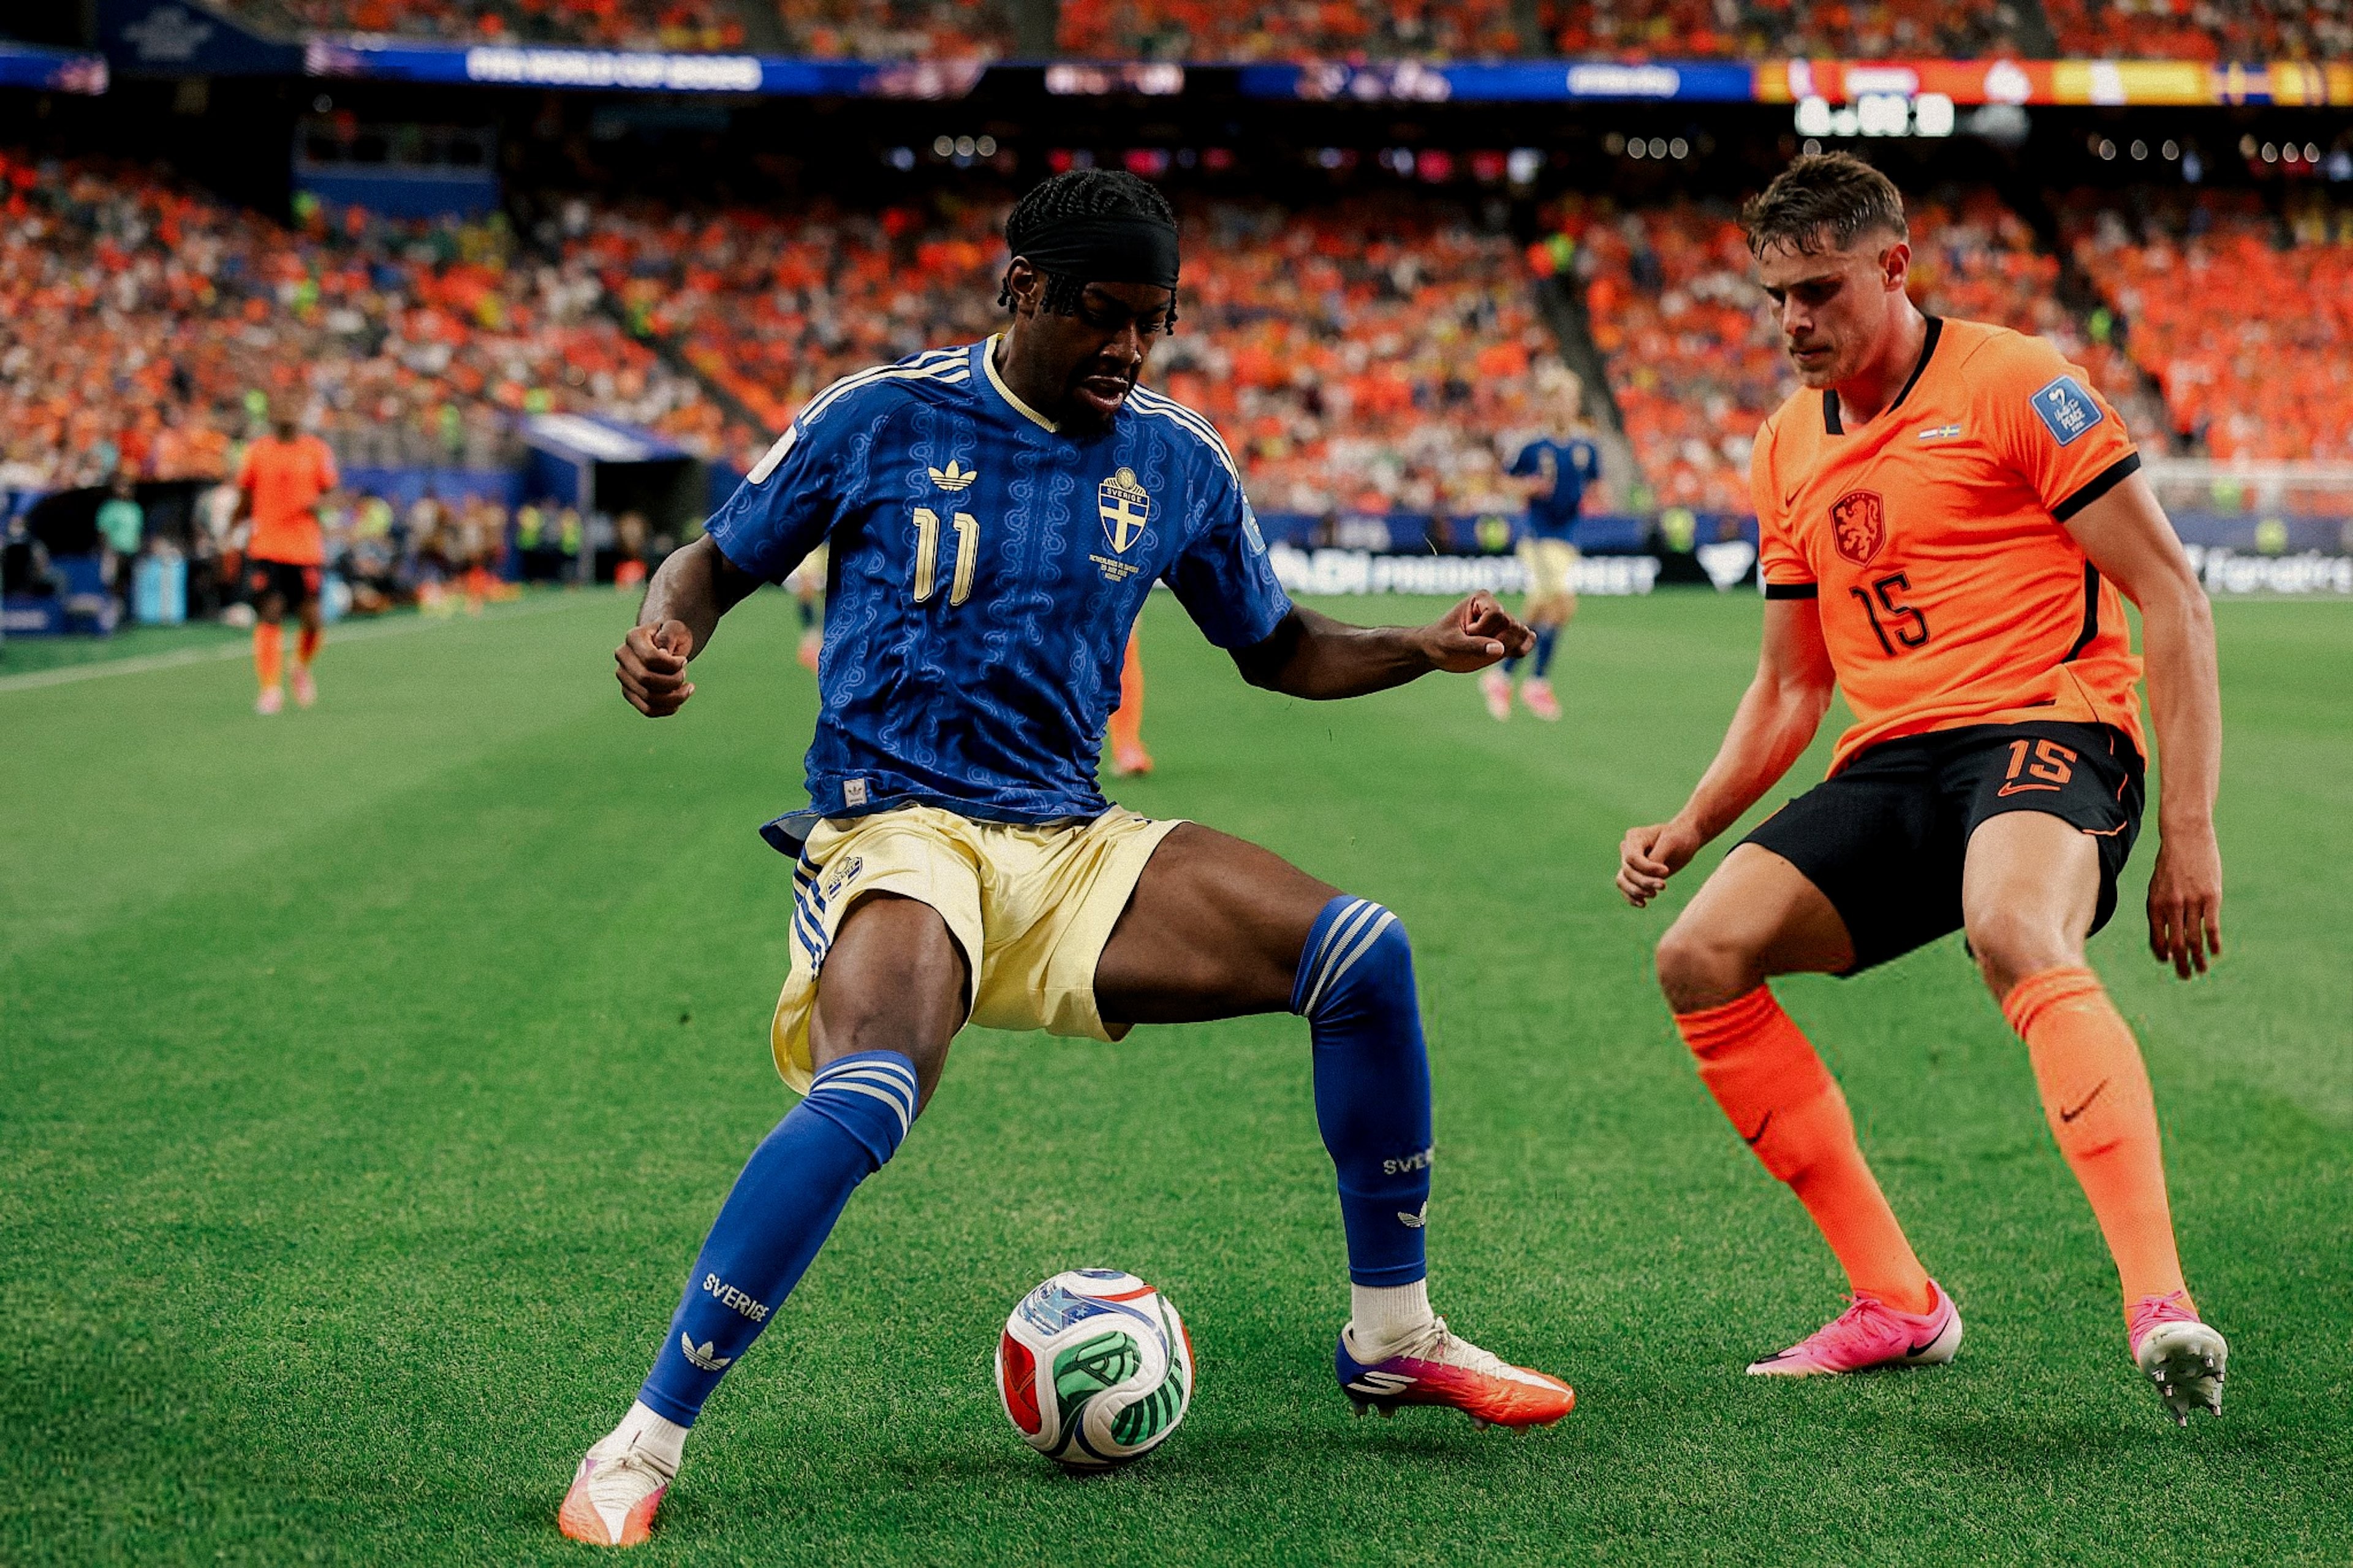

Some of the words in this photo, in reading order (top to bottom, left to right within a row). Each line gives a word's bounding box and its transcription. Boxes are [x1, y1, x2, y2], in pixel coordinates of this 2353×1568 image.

[1107, 488, 1142, 503] SVERIGE
[912, 507, 980, 606] 11
[1849, 570, 1930, 656] 15
[2006, 739, 2078, 784] 15
